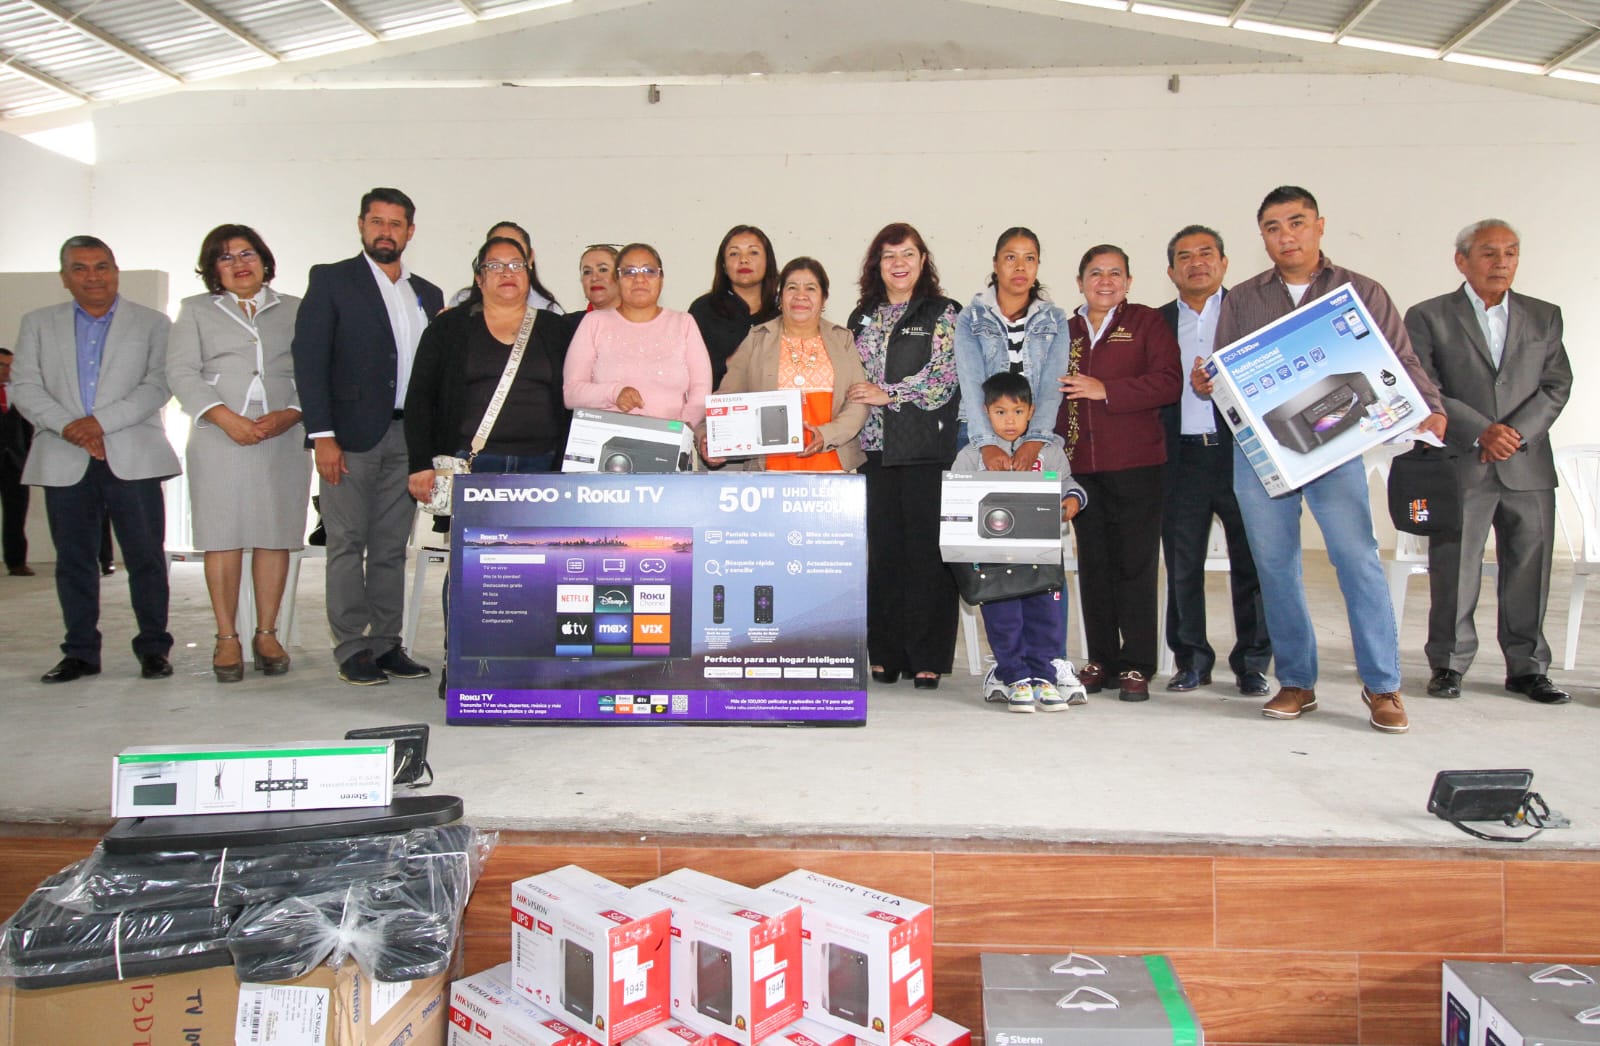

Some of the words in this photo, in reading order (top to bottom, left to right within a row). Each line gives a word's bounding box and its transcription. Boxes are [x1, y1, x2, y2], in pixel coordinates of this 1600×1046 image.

[463, 487, 559, 503] DAEWOO
[635, 486, 665, 503] TV
[719, 487, 775, 512] 50"
[782, 487, 809, 498] UHD
[561, 594, 590, 603] NETFLIX
[599, 623, 628, 634] max
[704, 655, 742, 664] Perfecto
[744, 657, 765, 665] para
[780, 655, 805, 665] hogar
[807, 655, 855, 665] inteligente
[481, 693, 493, 701] TV
[340, 792, 368, 801] Steren
[516, 893, 548, 916] HIKVISION
[516, 911, 529, 927] UPS
[625, 982, 645, 997] 1945
[184, 988, 204, 1015] TV
[455, 992, 488, 1020] HIKVISION
[454, 1010, 466, 1028] UPS
[1009, 1034, 1043, 1045] Steren
